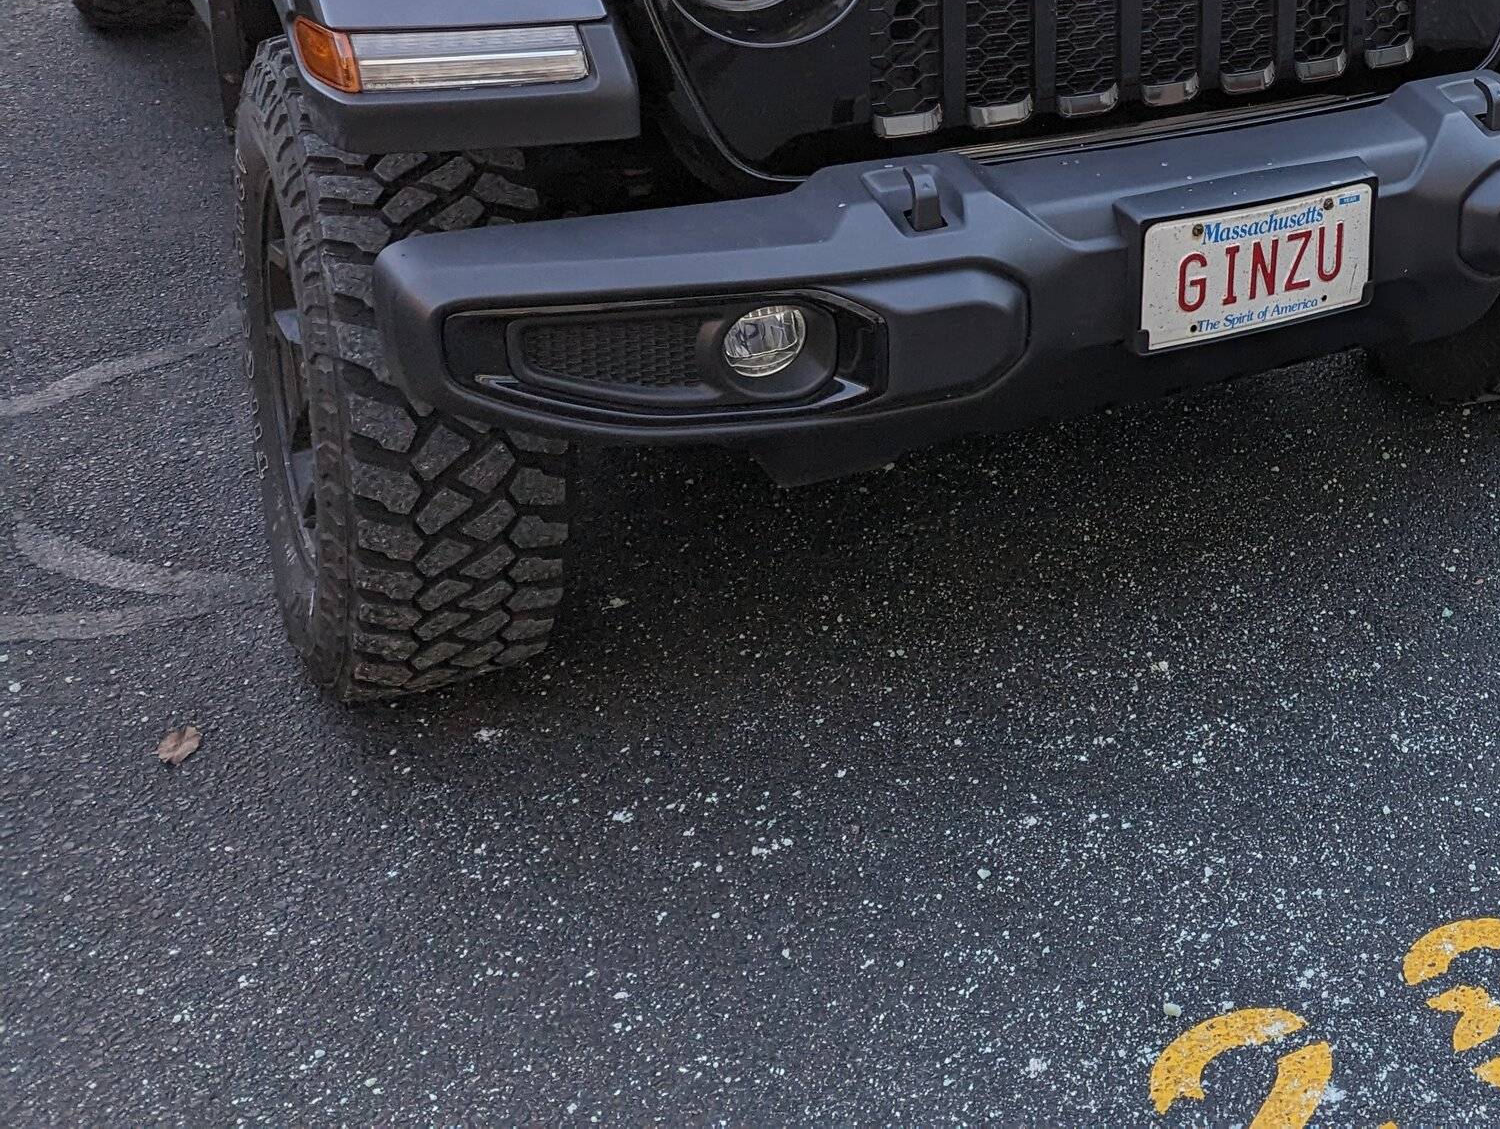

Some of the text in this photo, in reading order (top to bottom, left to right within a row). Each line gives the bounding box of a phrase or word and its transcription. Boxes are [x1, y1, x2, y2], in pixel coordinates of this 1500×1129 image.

[1201, 206, 1325, 245] Massachusetts
[1177, 221, 1344, 313] GINZU
[1198, 298, 1318, 332] The Spirit of America
